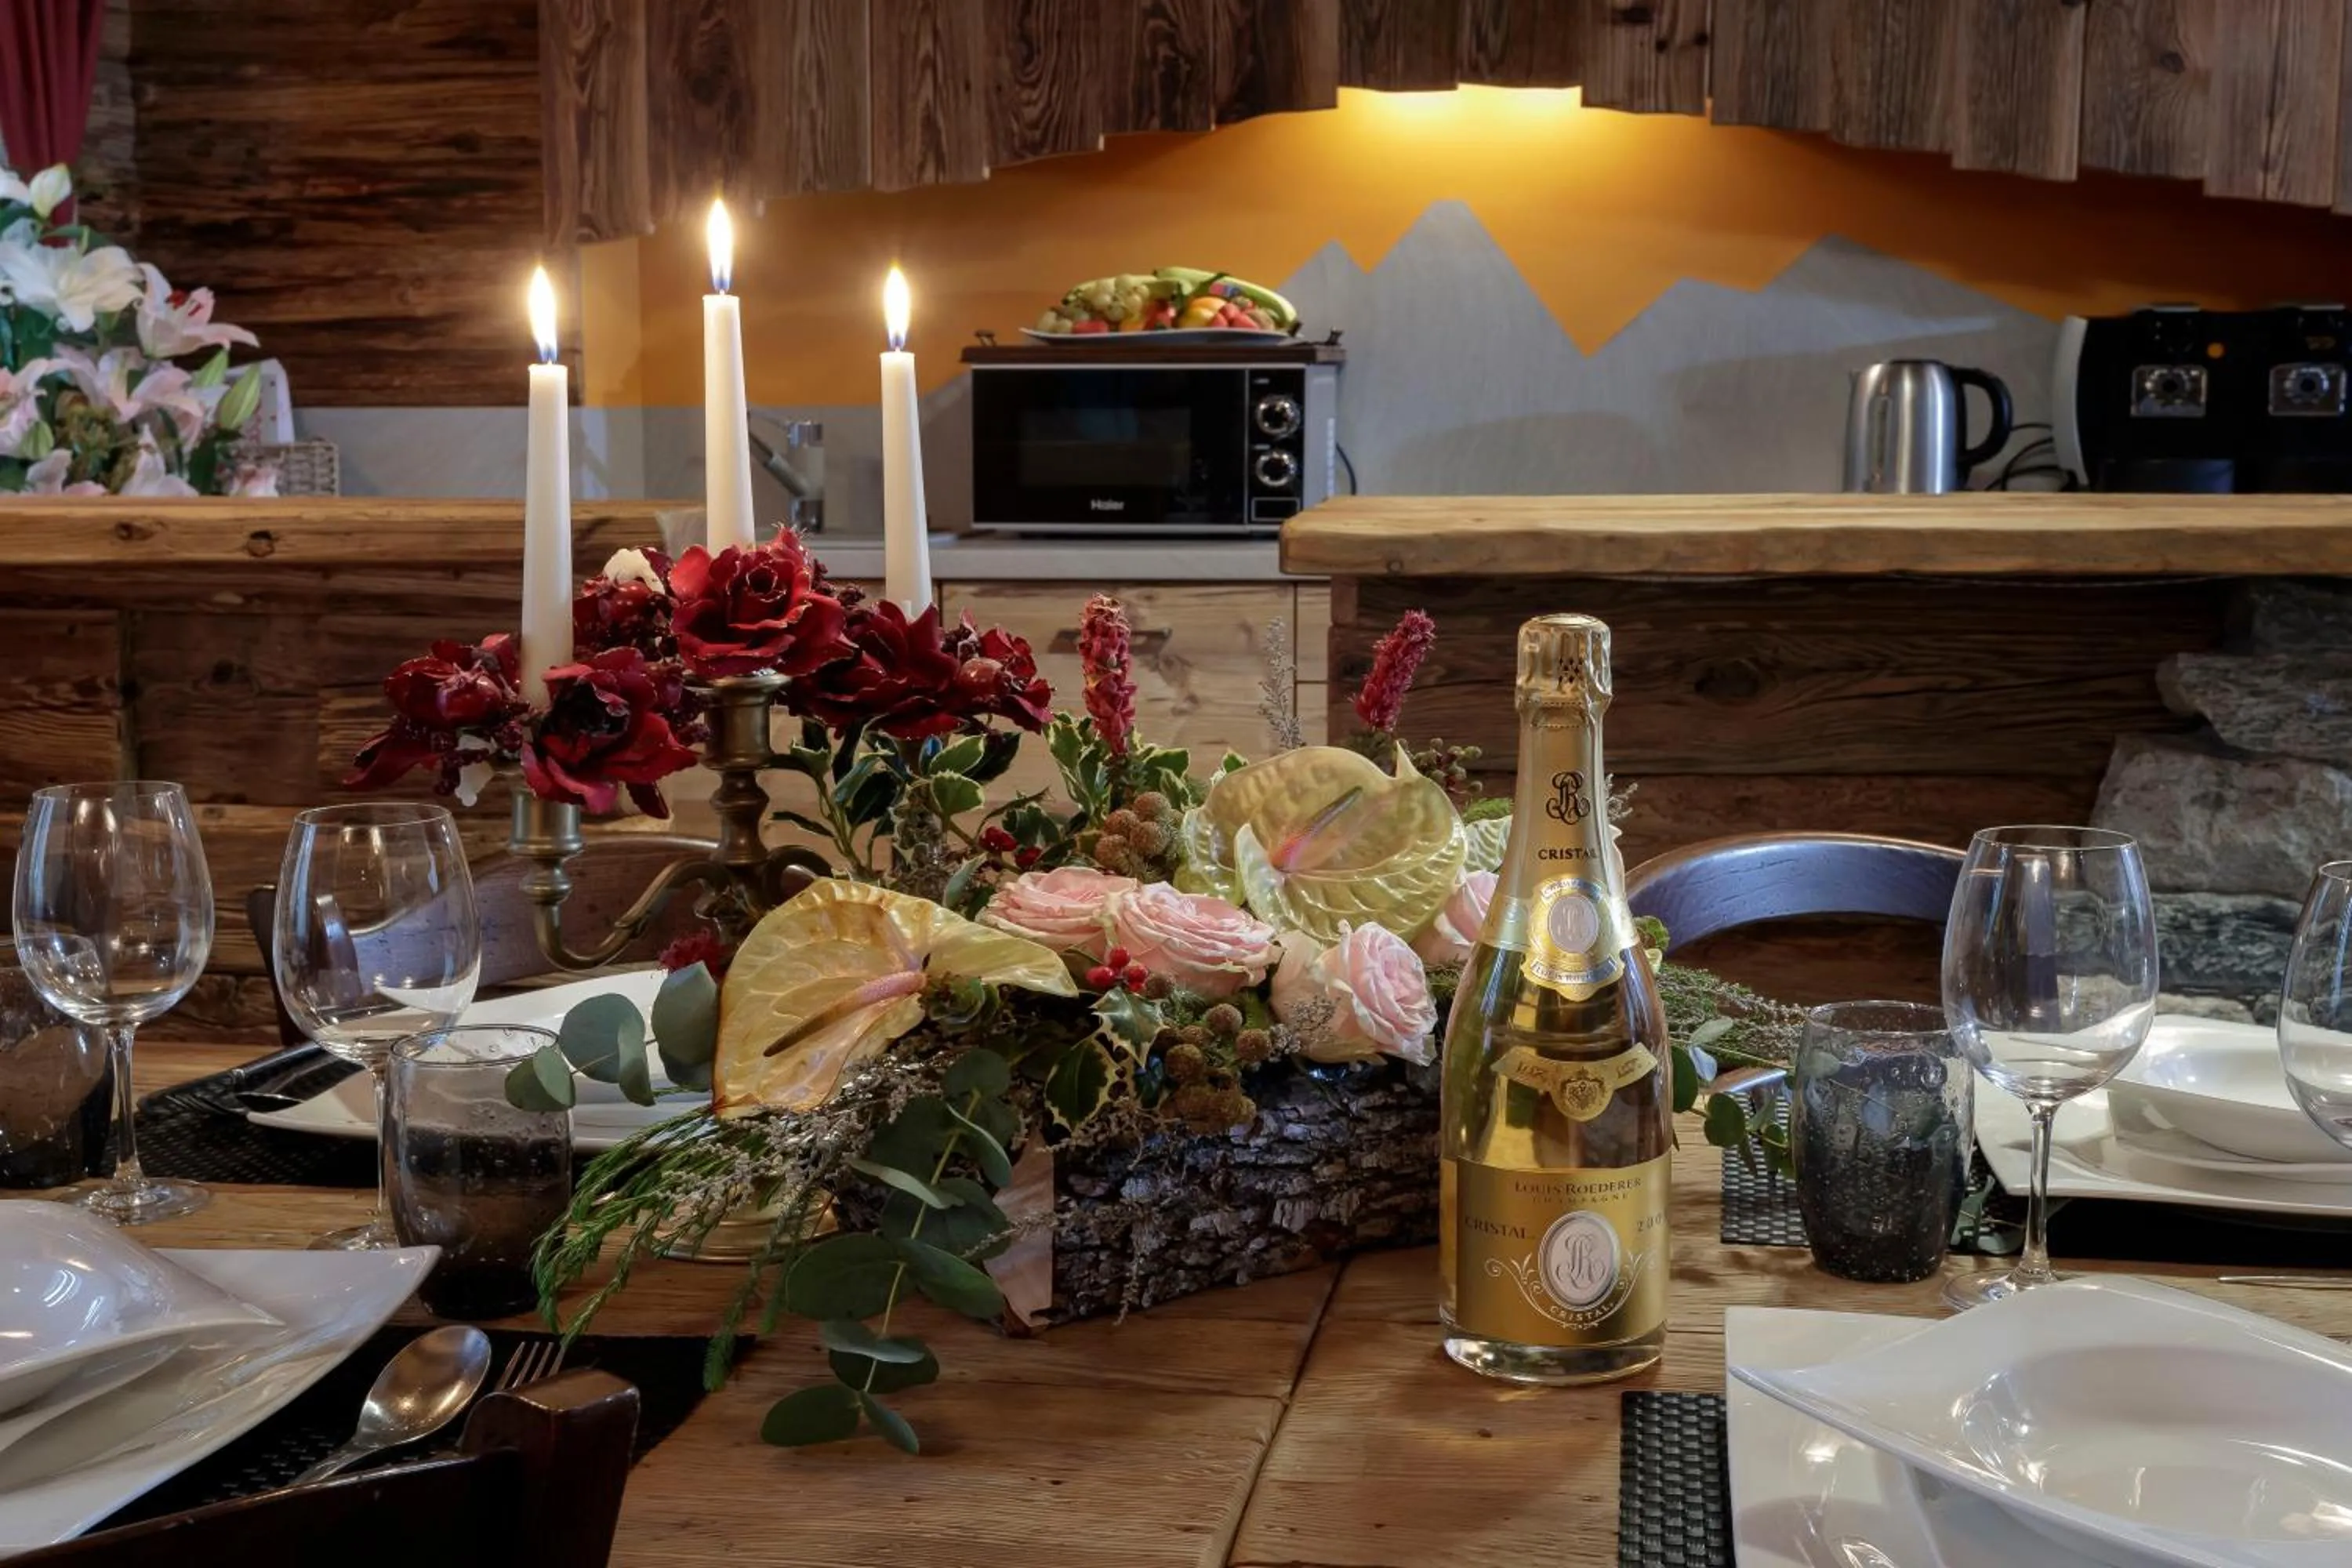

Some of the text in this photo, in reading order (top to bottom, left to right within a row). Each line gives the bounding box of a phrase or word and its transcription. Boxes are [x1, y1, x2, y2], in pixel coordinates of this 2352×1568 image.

[1090, 498, 1125, 510] Haier
[1537, 848, 1598, 860] CRISTAL
[1515, 1177, 1642, 1196] LOUIS ROEDERER
[1464, 1214, 1534, 1240] CRISTAL
[1549, 1303, 1610, 1322] CRISTAL
